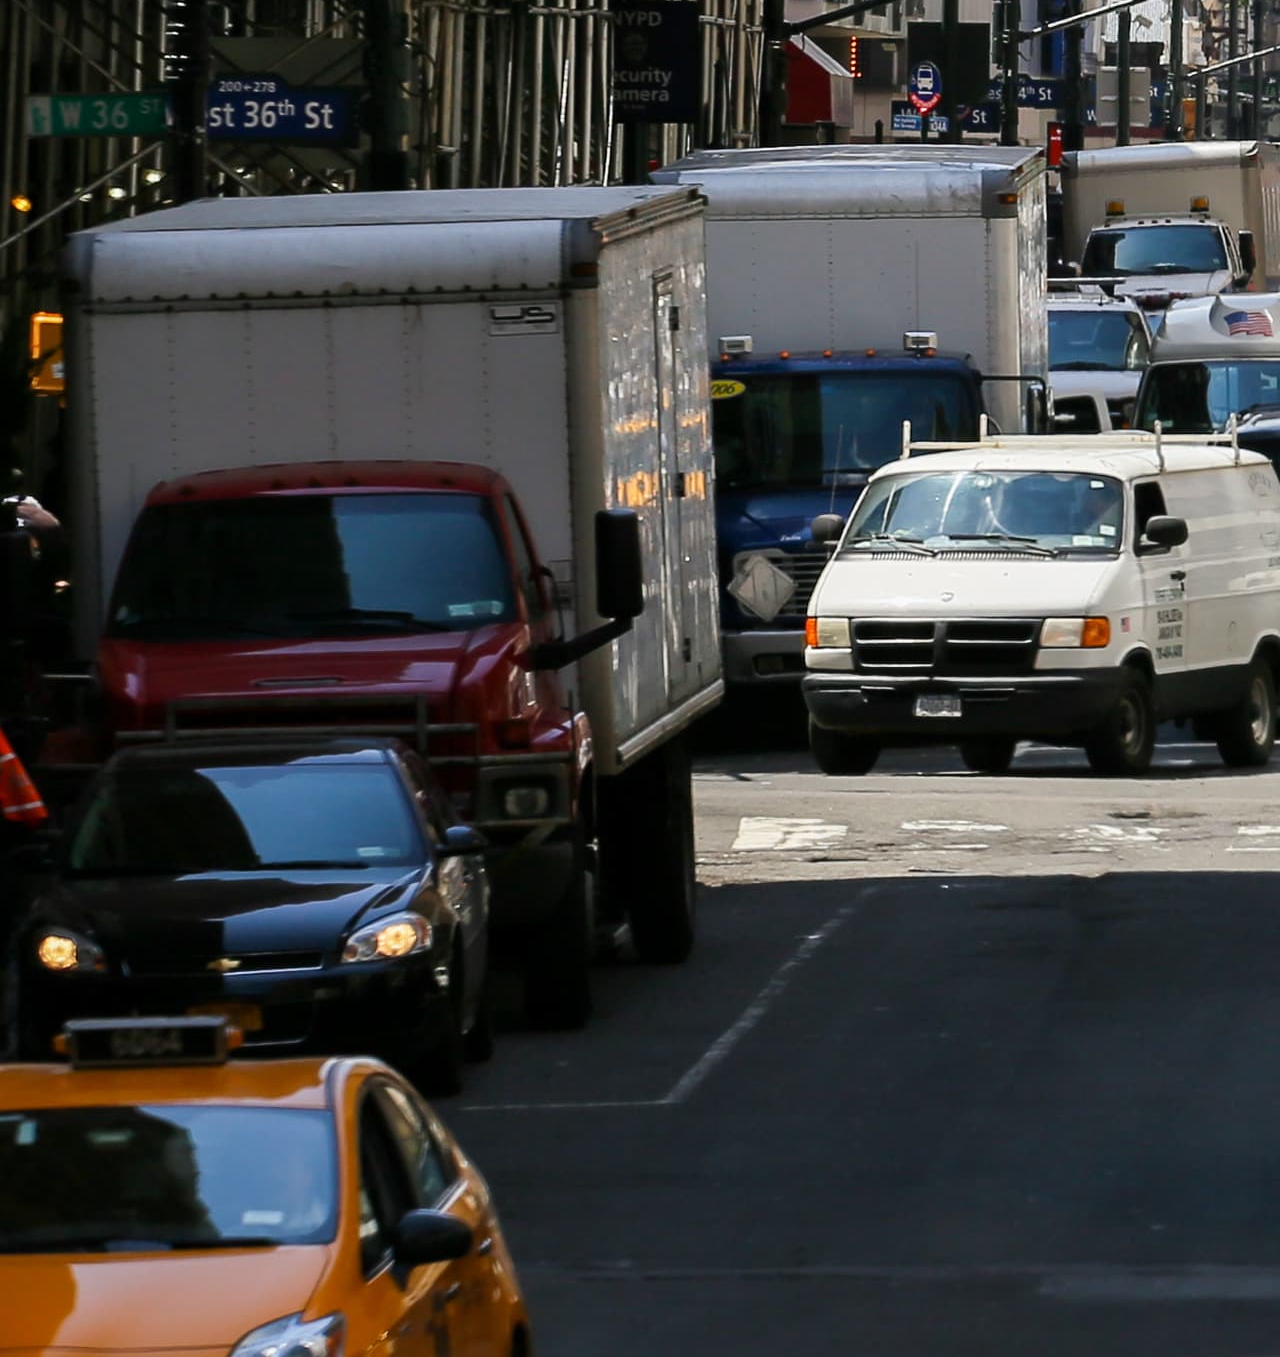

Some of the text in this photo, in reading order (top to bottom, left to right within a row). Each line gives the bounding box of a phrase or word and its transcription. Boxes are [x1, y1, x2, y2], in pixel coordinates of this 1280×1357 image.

[612, 67, 672, 87] ecurity
[612, 88, 670, 102] amera
[1038, 87, 1053, 101] St
[58, 98, 162, 130] W 36 ST
[243, 98, 296, 129] 36th
[304, 100, 335, 130] St
[971, 109, 987, 124] St
